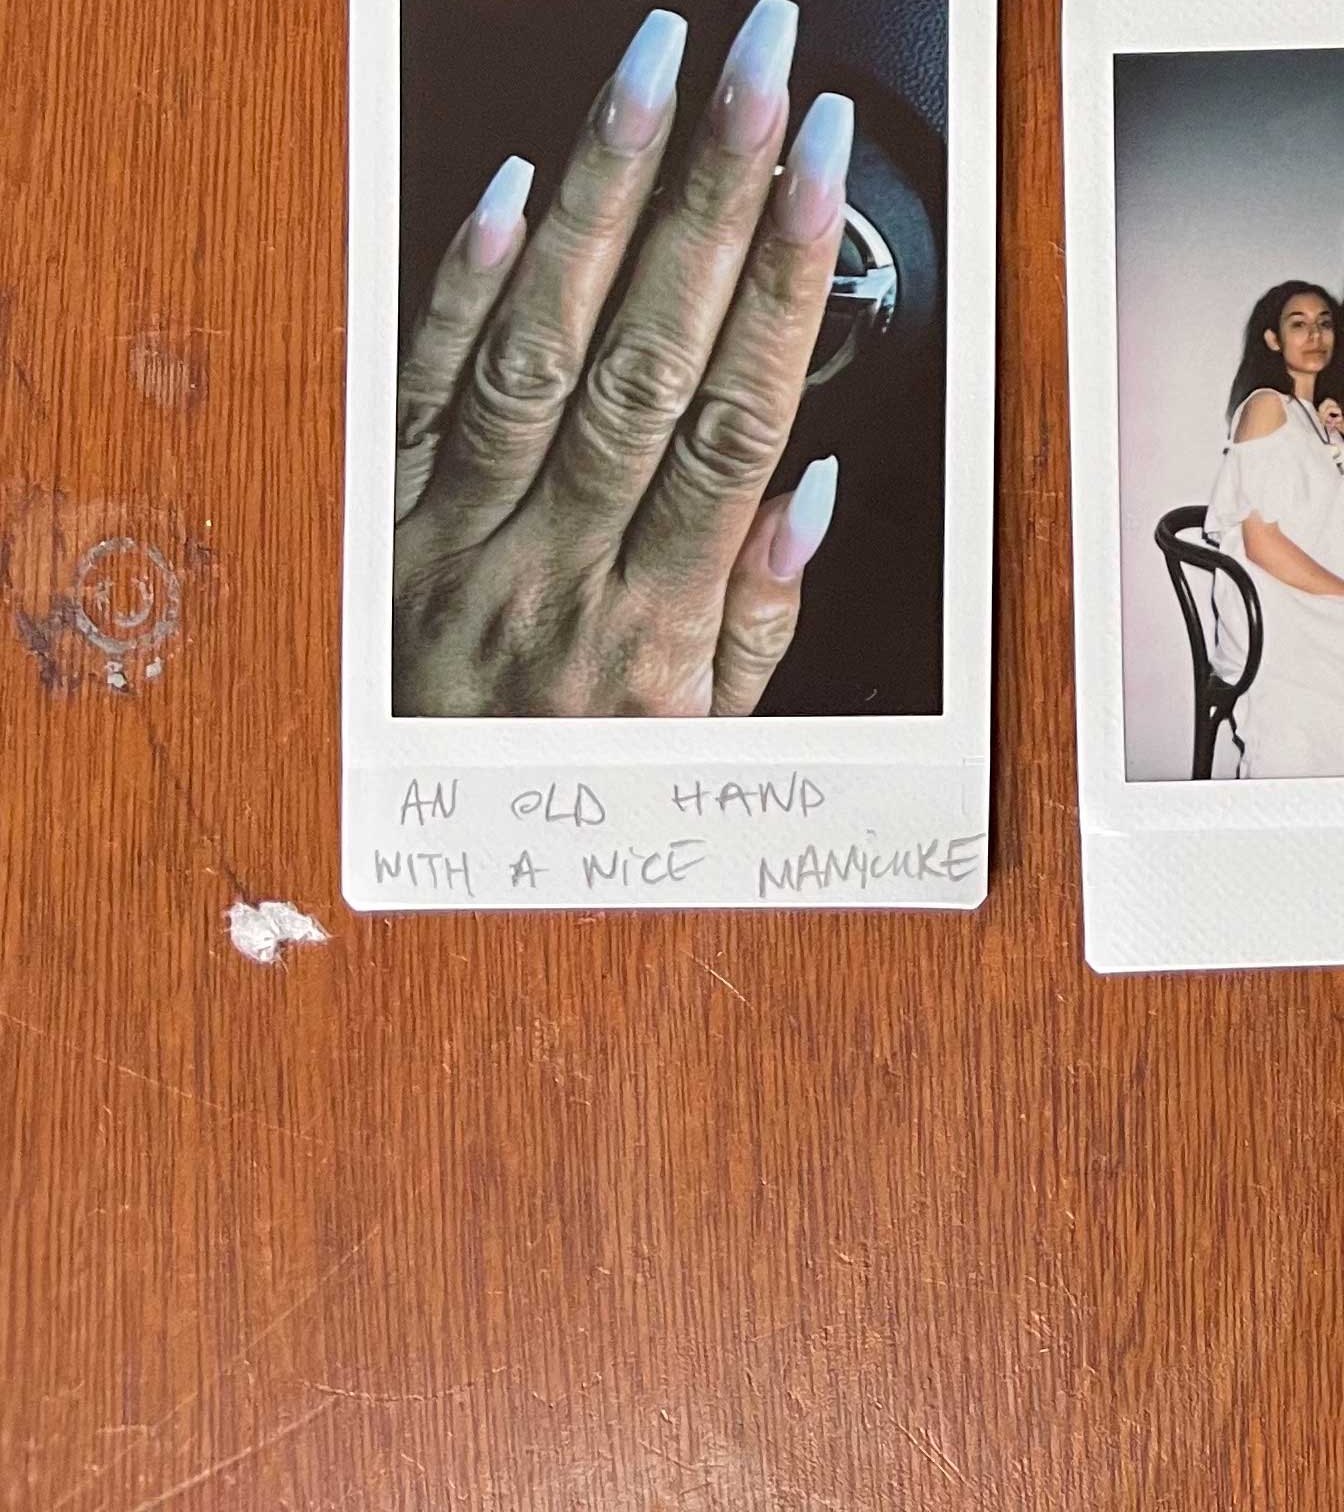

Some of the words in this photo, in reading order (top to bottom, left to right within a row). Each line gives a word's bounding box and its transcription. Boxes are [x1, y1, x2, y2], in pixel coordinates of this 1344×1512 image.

[399, 777, 459, 826] AN
[511, 782, 607, 827] OLD
[672, 770, 826, 816] HAND
[374, 846, 476, 897] WITH
[511, 848, 549, 888] A
